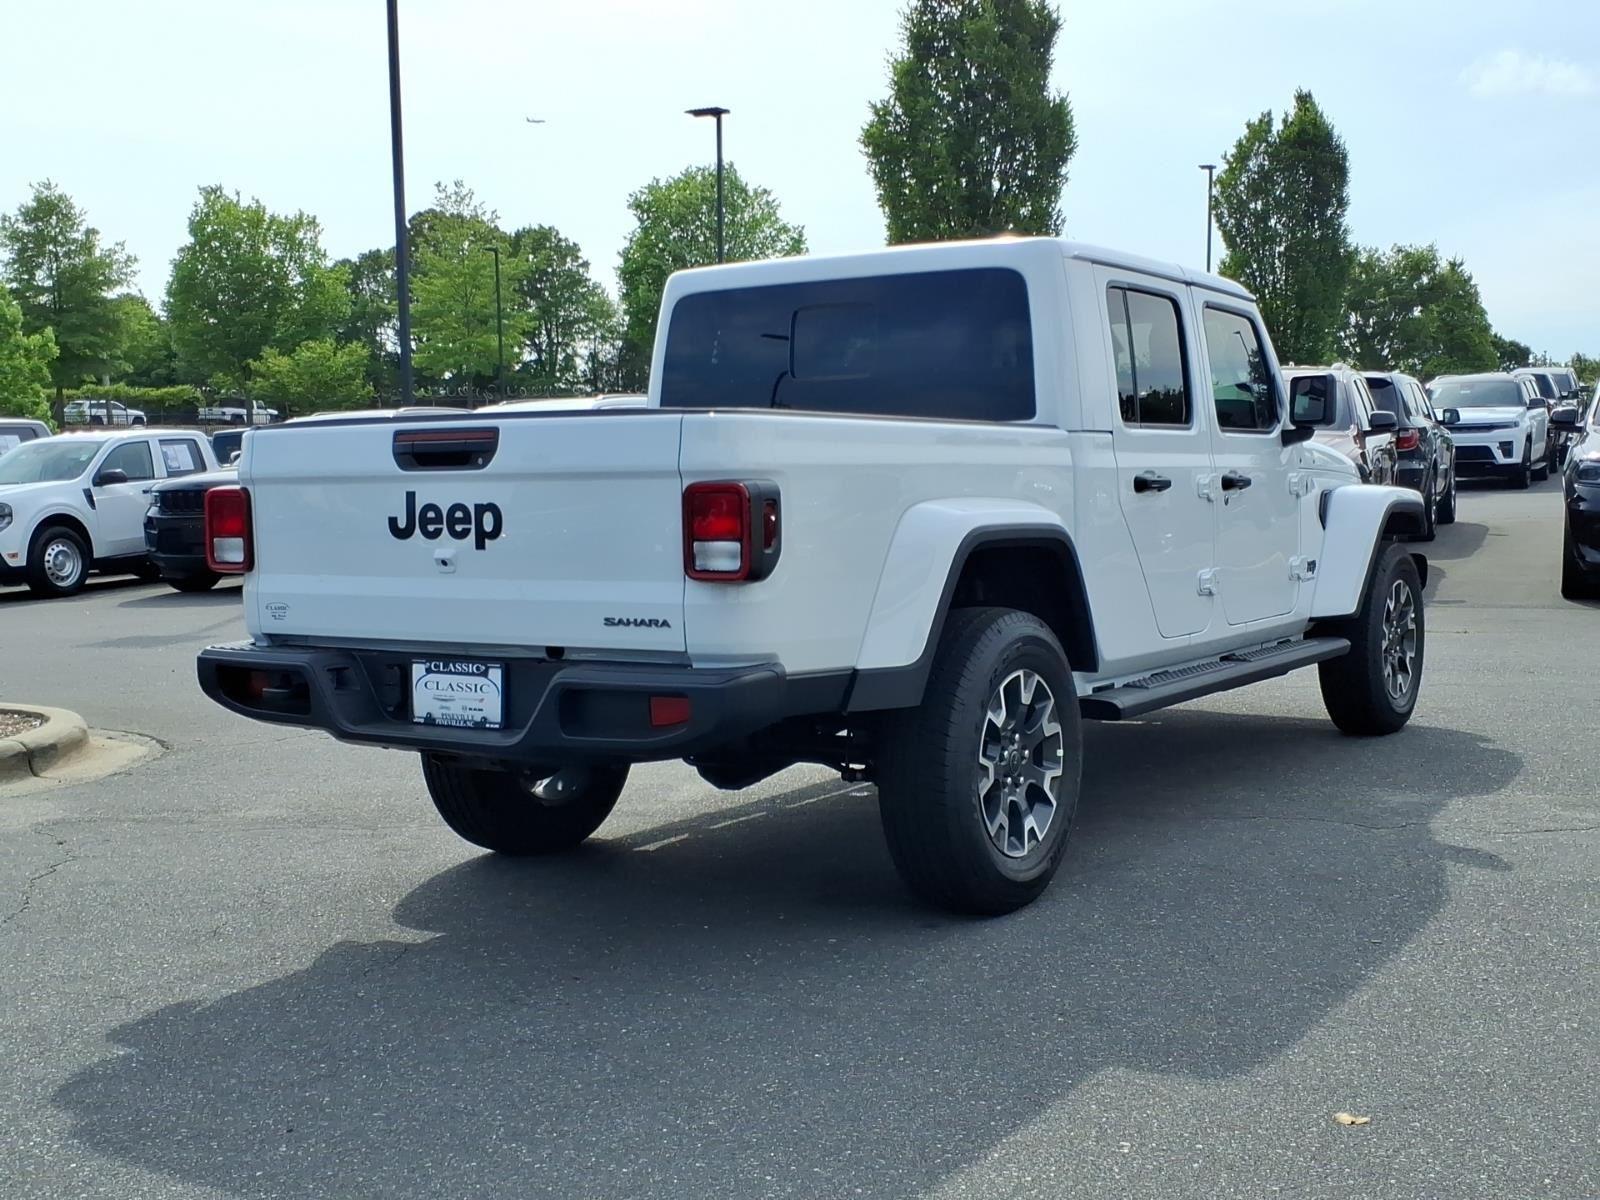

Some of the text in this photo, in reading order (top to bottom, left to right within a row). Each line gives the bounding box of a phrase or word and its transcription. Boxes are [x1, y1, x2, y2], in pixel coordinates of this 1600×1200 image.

[388, 491, 502, 550] Jeep
[603, 617, 671, 628] SAHARA
[431, 661, 482, 673] CLASSIC
[424, 680, 490, 694] CLASSIC
